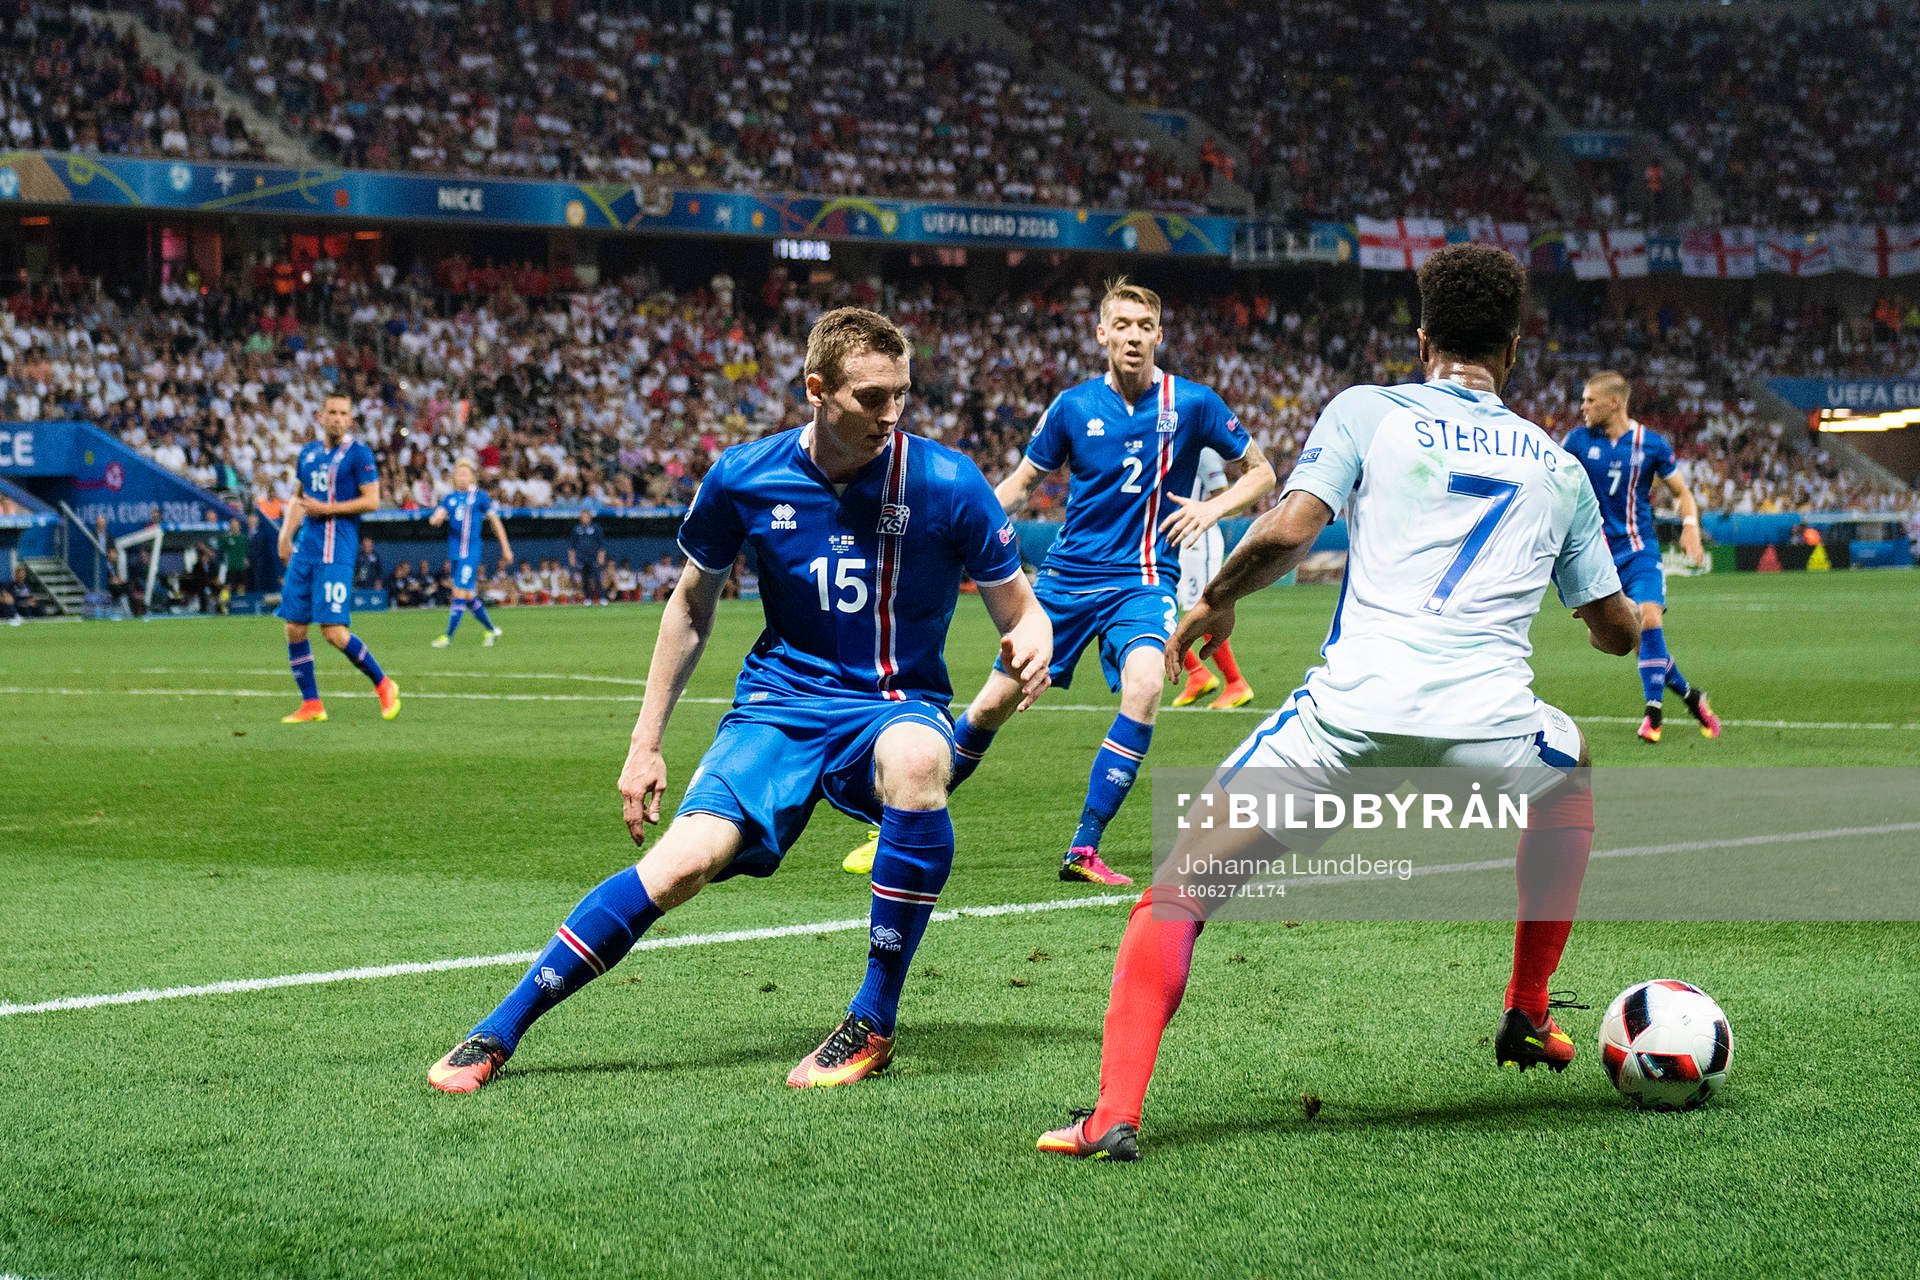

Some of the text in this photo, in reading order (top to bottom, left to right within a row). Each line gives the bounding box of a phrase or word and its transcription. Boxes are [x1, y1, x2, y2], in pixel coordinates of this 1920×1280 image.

[438, 187, 483, 211] NICE
[922, 212, 1059, 238] UEFA EURO 2016
[1827, 383, 1920, 406] UEFA EU
[0, 431, 34, 466] CE
[1414, 419, 1557, 472] STERLING
[310, 470, 329, 492] 10
[1121, 456, 1143, 493] 2
[1608, 470, 1622, 496] 7
[771, 520, 797, 529] errea
[1417, 471, 1523, 615] 7
[324, 581, 348, 604] 10
[809, 557, 868, 613] 15
[1188, 576, 1199, 597] 3
